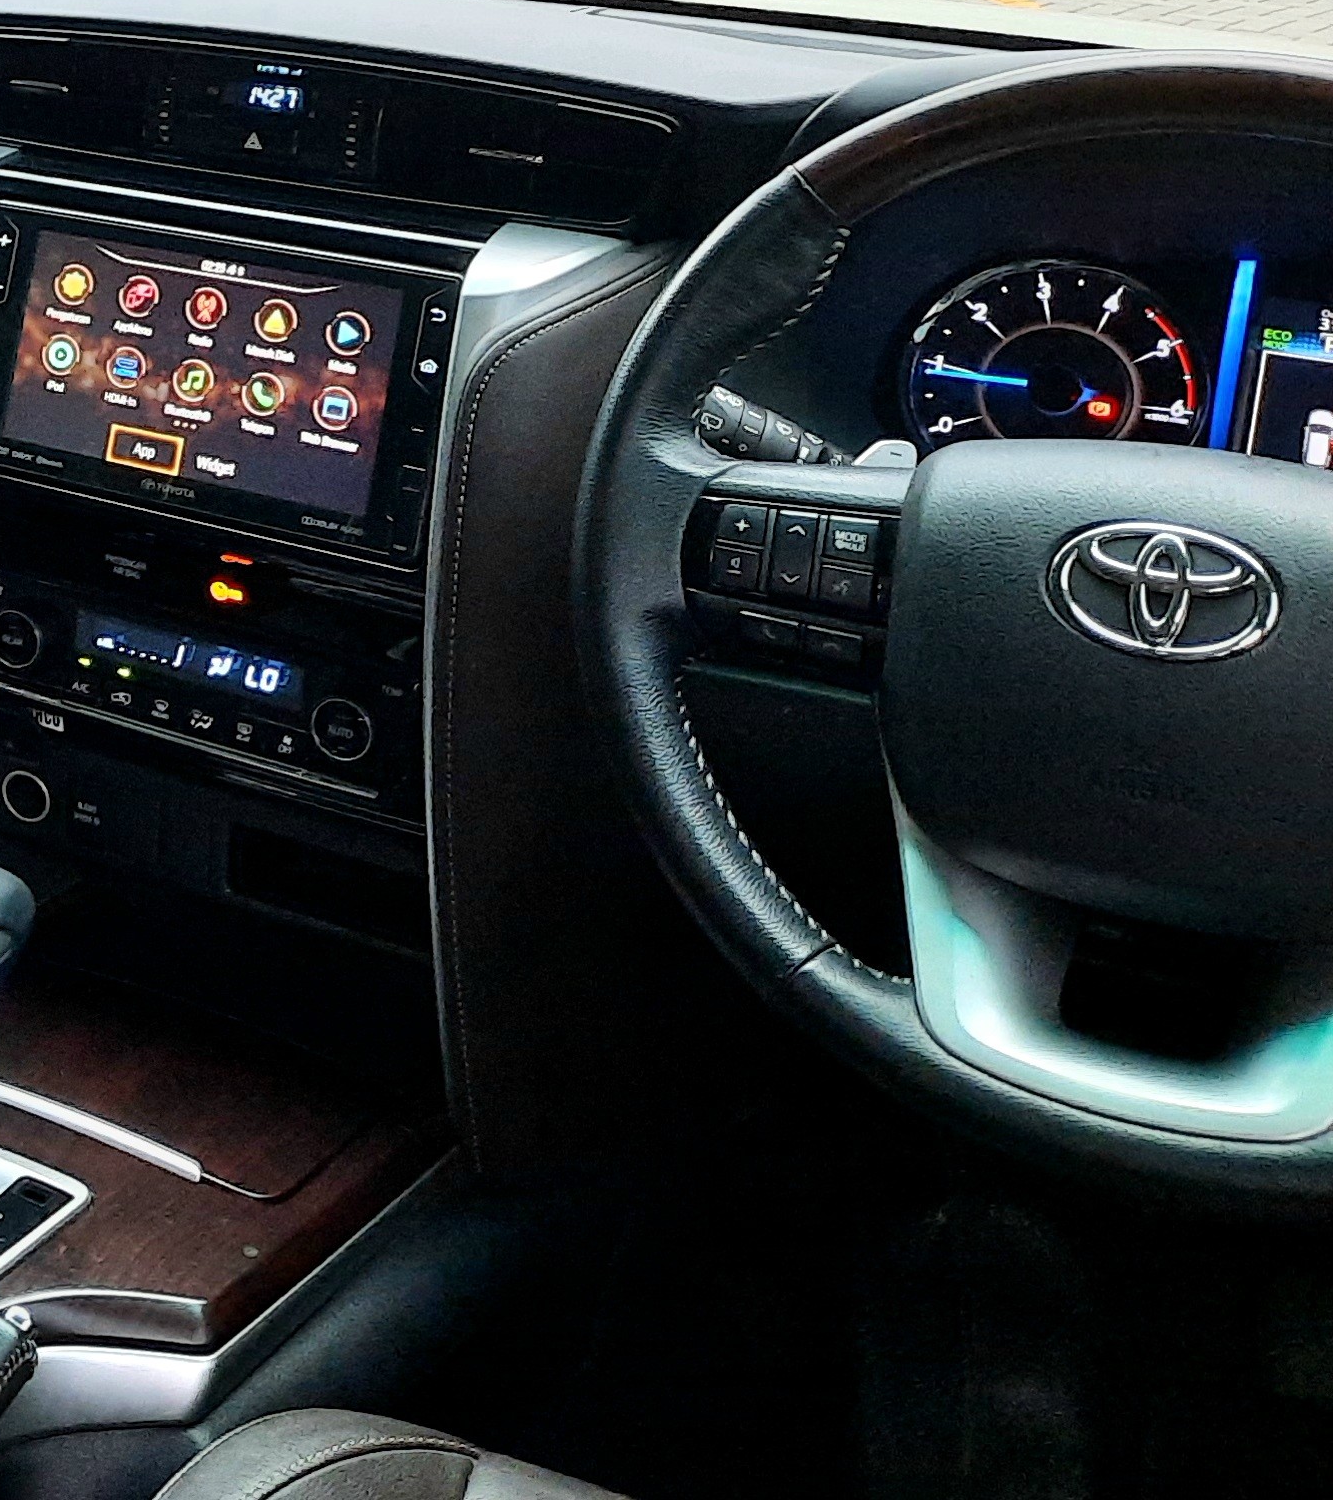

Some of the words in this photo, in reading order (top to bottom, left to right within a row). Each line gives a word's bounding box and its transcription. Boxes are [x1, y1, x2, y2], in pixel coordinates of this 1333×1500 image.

[1263, 328, 1293, 342] ECO
[132, 442, 156, 460] App
[195, 455, 236, 478] Widget
